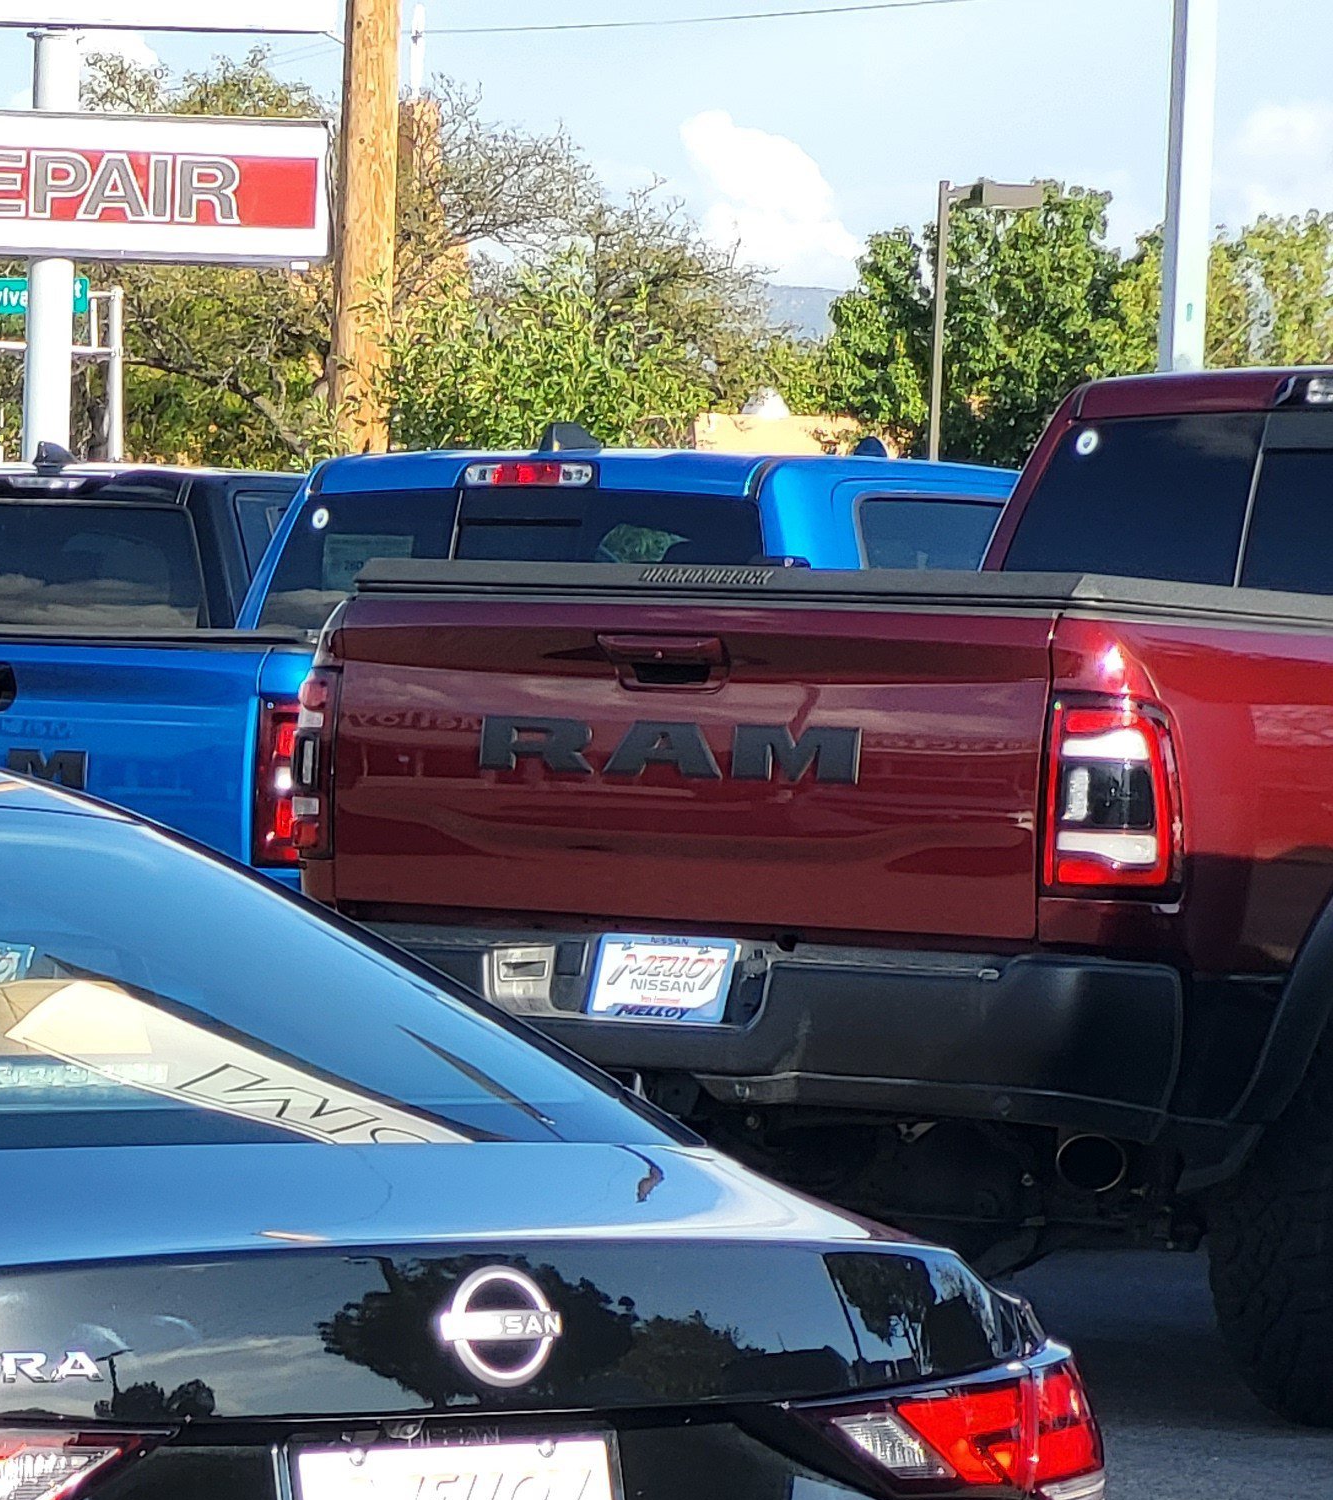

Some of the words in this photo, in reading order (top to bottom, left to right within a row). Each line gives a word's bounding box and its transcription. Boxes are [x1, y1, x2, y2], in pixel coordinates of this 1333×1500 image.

[479, 714, 862, 785] RAM
[649, 936, 690, 946] NISSAN
[606, 953, 727, 991] MELLOY
[631, 978, 696, 993] NISSAN
[614, 1004, 691, 1020] MELLOY
